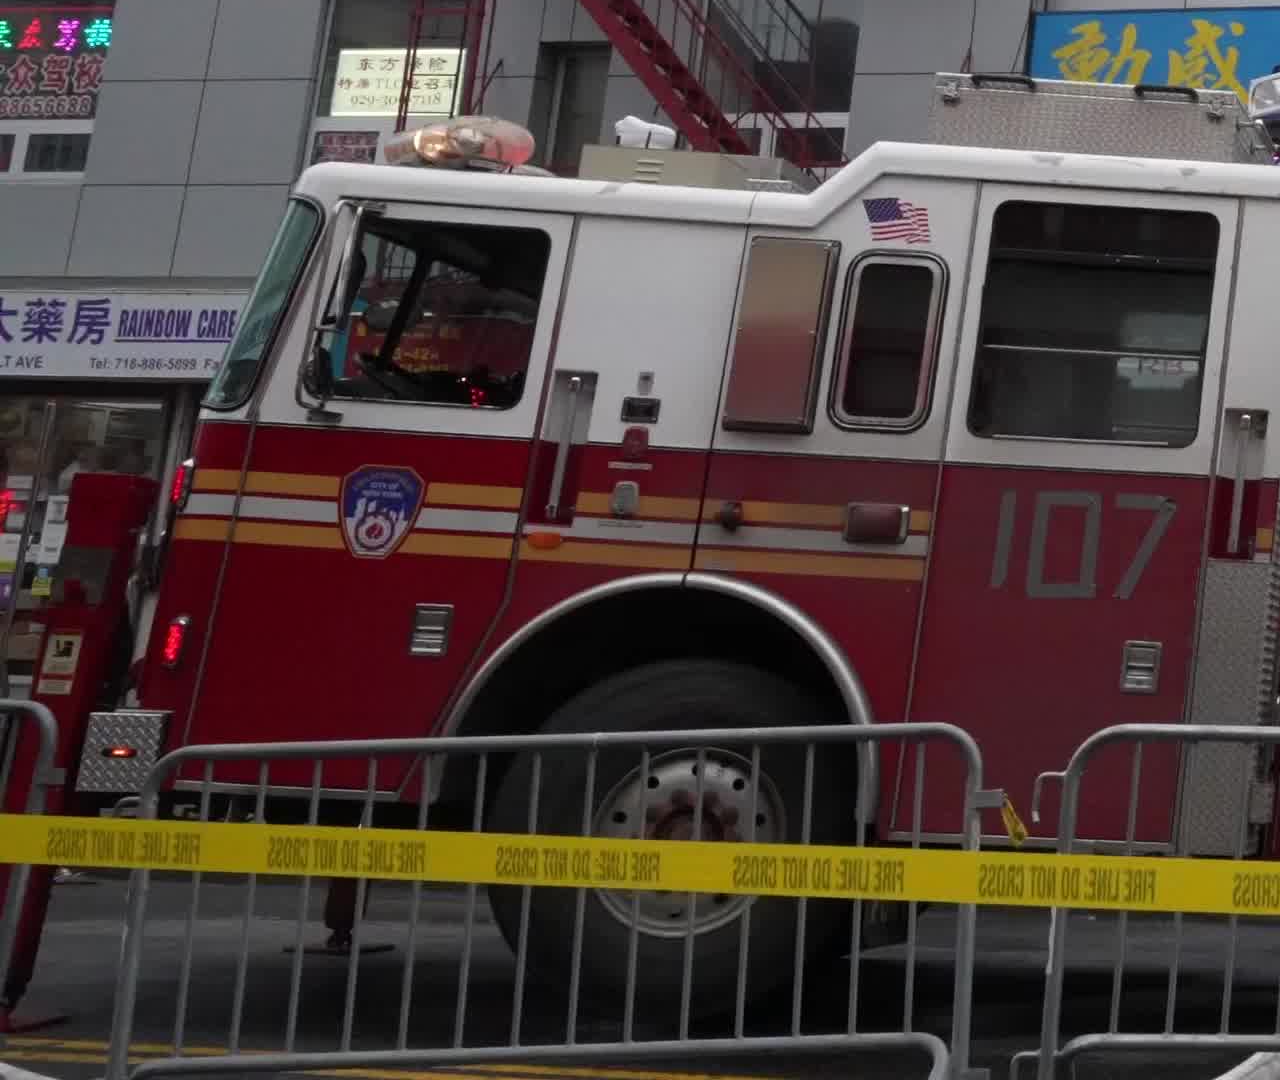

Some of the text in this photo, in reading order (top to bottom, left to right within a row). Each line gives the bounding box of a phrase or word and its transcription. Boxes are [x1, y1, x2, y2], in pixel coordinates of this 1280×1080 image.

[0, 54, 104, 93] 众驾校
[117, 309, 192, 338] RAINBOW
[196, 309, 238, 338] CARE
[15, 355, 44, 369] AVE
[990, 490, 1178, 600] 107
